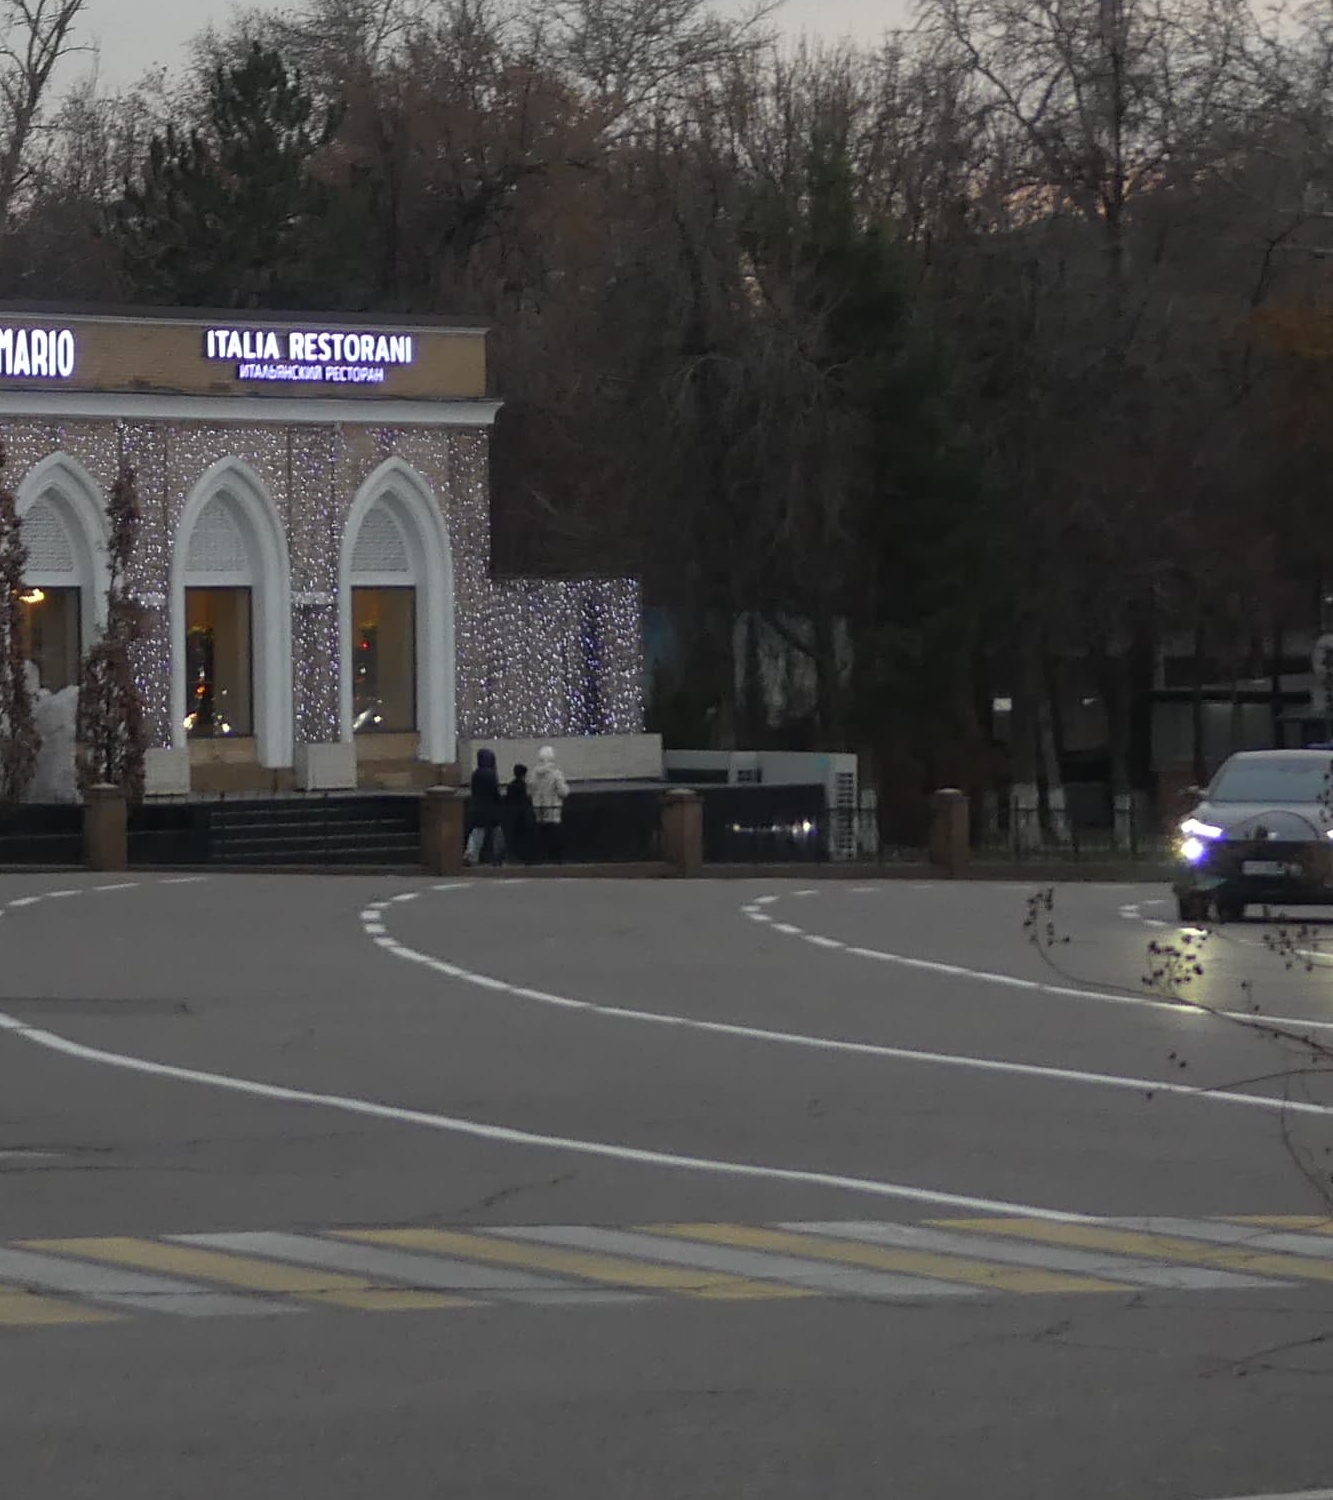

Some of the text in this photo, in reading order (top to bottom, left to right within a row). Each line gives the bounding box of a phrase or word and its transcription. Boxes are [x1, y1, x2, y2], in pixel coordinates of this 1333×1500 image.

[207, 330, 412, 363] ITALIA RESTORANI
[325, 366, 384, 382] РЕСТОРАН
